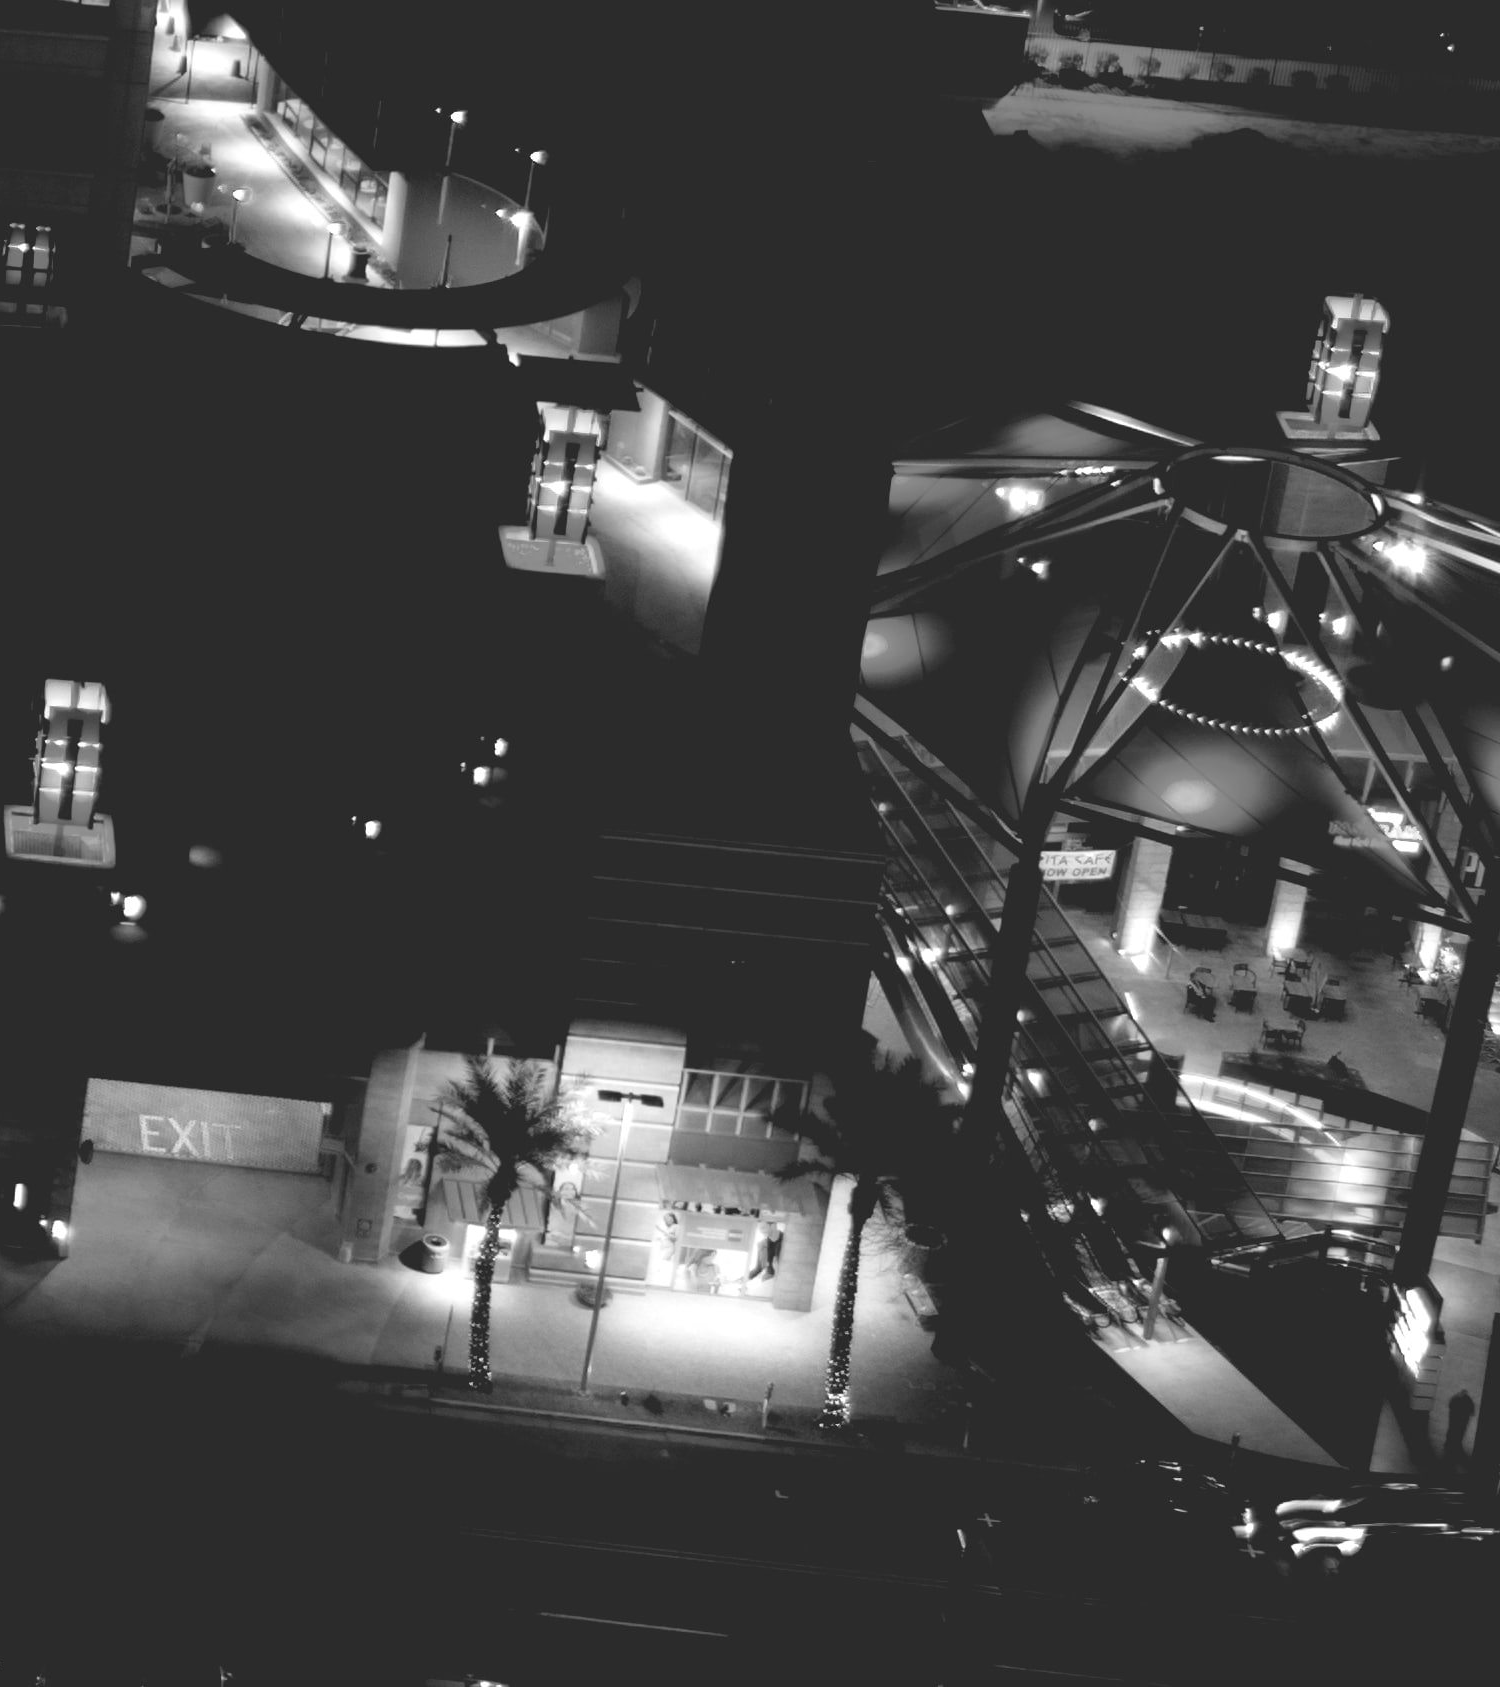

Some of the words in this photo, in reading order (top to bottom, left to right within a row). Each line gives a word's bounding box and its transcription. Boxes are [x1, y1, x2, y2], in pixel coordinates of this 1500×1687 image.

[1042, 855, 1068, 865] ITA
[1072, 866, 1108, 877] OPEN
[138, 1112, 241, 1161] EXIT
